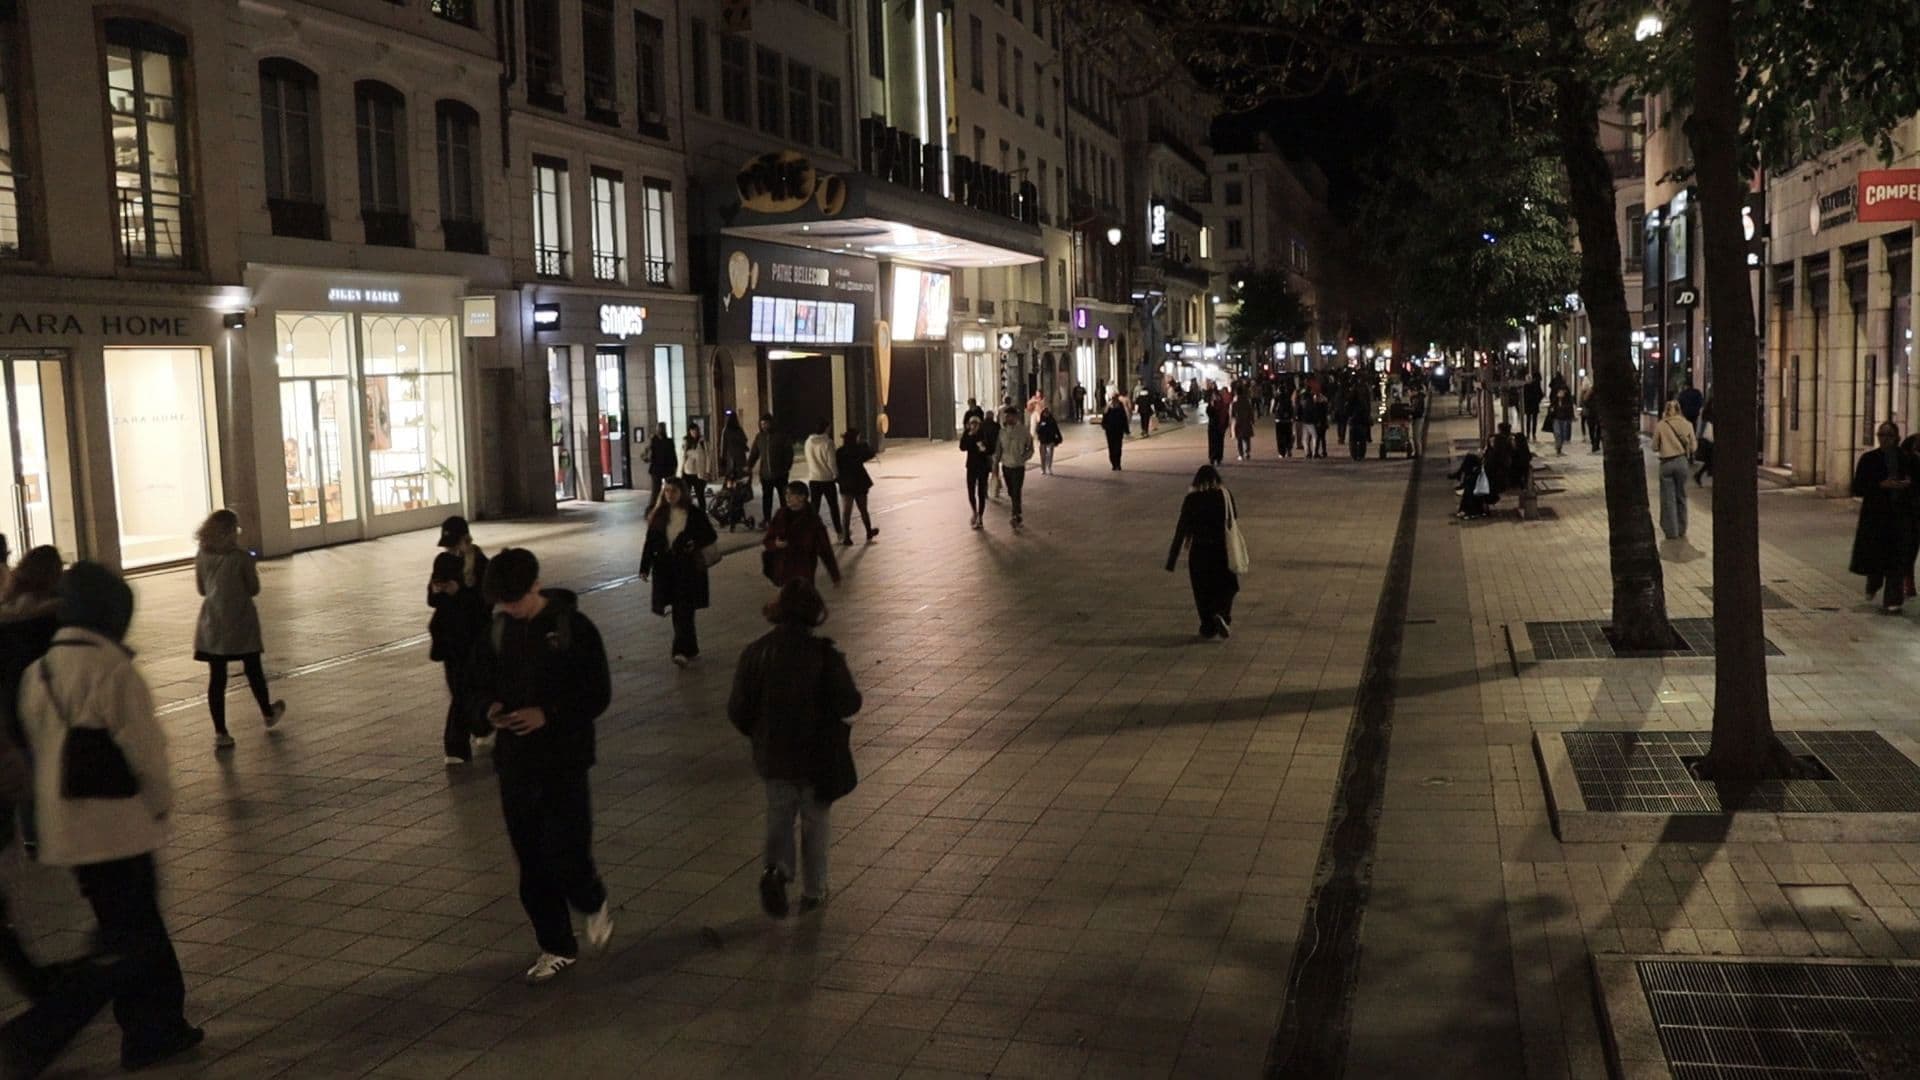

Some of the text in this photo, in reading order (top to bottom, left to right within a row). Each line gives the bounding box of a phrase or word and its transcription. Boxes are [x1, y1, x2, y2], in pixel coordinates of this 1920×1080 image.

[1866, 184, 1920, 206] CAMPE
[1676, 292, 1695, 304] JD
[0, 313, 191, 337] ARA HOME
